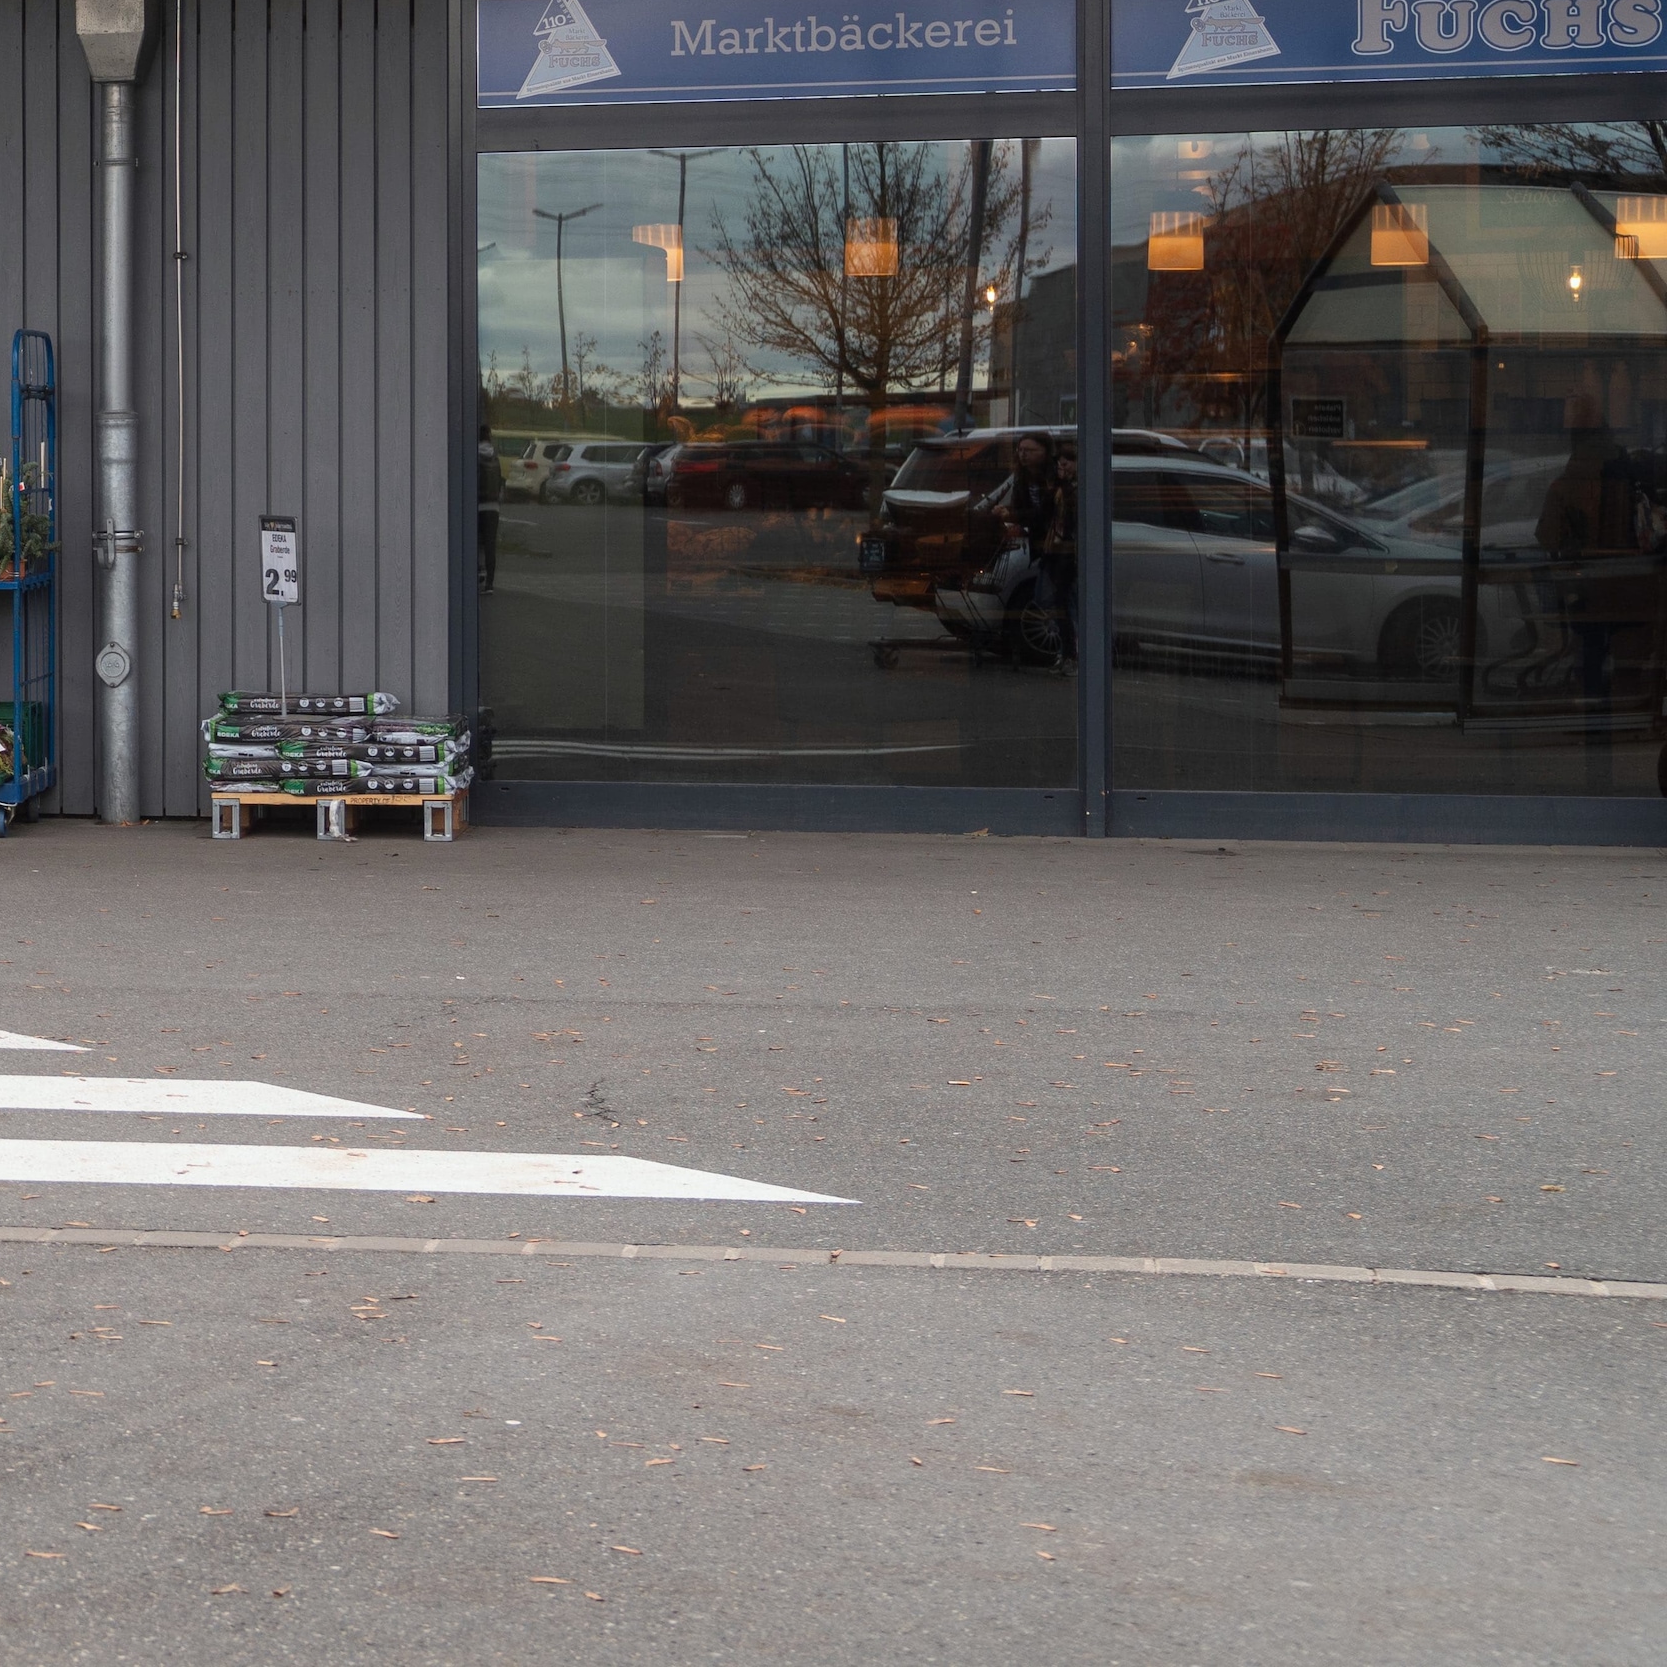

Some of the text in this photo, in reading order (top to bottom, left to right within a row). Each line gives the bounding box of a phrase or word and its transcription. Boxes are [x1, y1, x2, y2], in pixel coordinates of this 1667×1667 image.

[542, 14, 567, 30] 110
[670, 8, 1018, 56] Marktbäckerei
[1201, 31, 1259, 47] FUCHS
[548, 53, 601, 68] FUCHS
